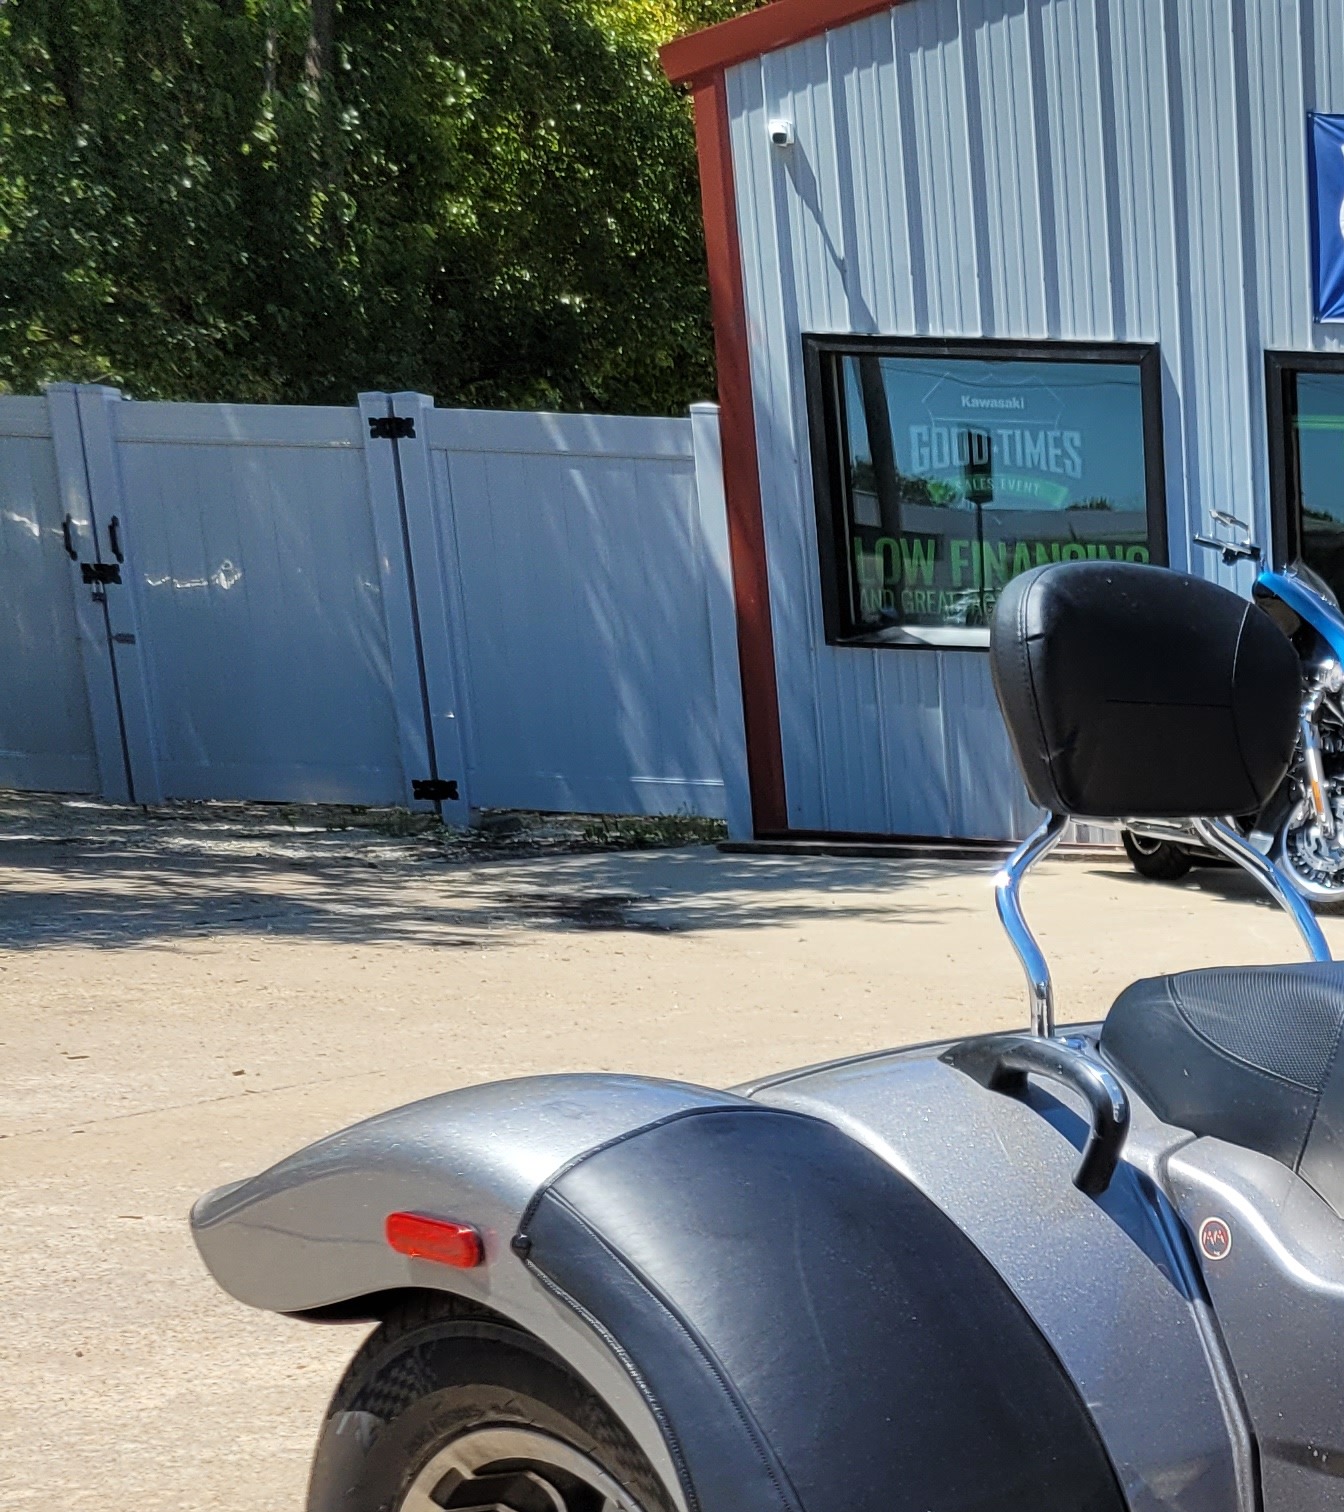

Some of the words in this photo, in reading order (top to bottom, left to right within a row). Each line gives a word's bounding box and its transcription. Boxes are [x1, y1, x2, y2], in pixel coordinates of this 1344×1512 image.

[961, 395, 1026, 410] Kawasaki
[909, 425, 990, 474] GOOD
[998, 429, 1082, 479] TIMES
[957, 478, 995, 490] SALES
[1000, 479, 1042, 496] EVENT
[853, 537, 935, 588] LOW
[860, 588, 895, 612] AND
